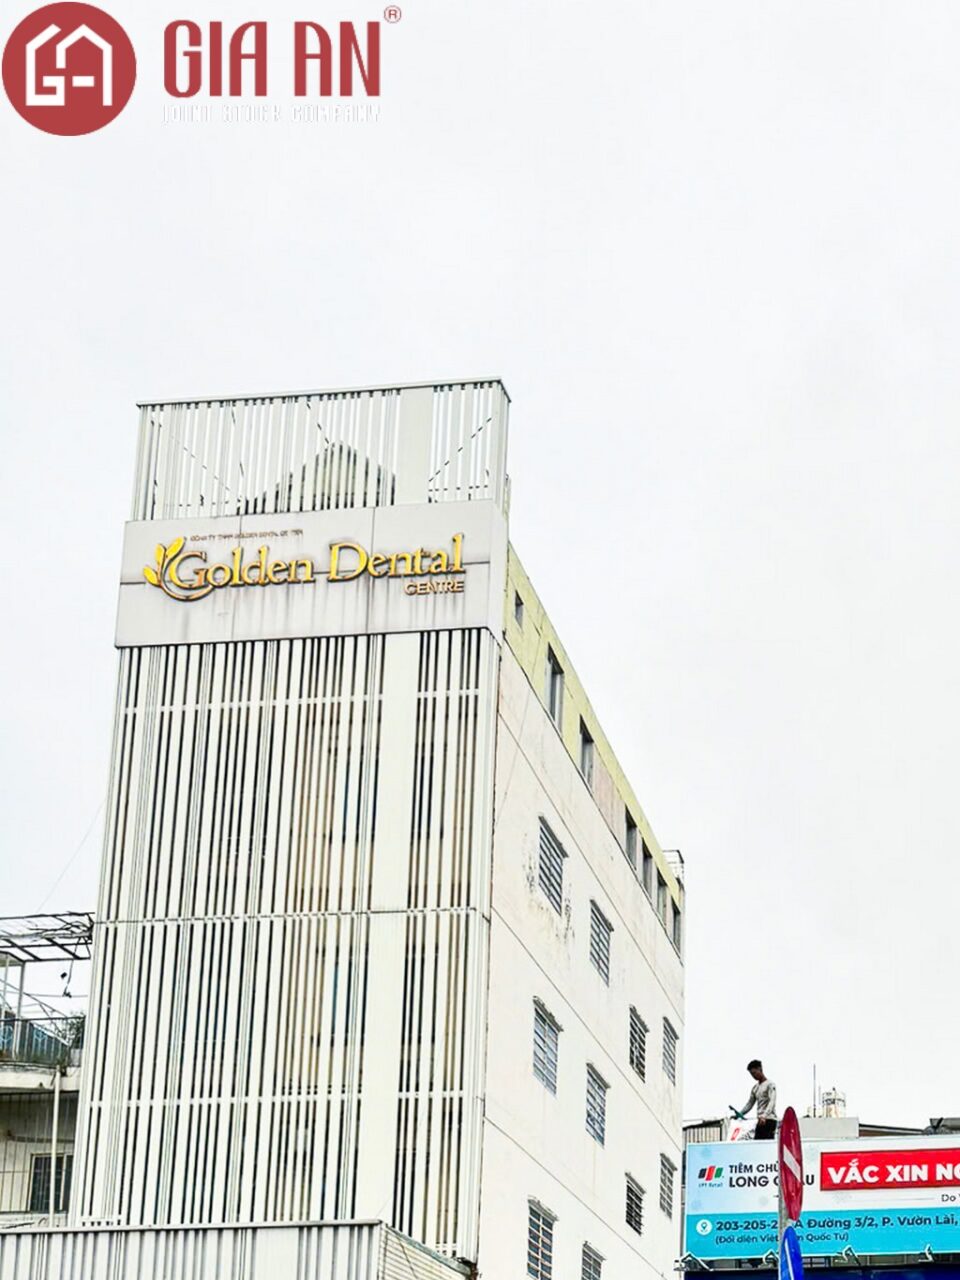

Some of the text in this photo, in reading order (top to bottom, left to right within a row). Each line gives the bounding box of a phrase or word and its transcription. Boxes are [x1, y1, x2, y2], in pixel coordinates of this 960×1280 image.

[168, 533, 467, 592] Golden Dental
[404, 580, 465, 597] CENTRE
[728, 1162, 754, 1174] TIÊM
[826, 1158, 879, 1185] VẮC
[885, 1164, 929, 1183] XIN
[728, 1175, 769, 1188] LONG
[941, 1193, 956, 1203] Do
[807, 1218, 851, 1231] Đường
[898, 1214, 932, 1227] Vườn
